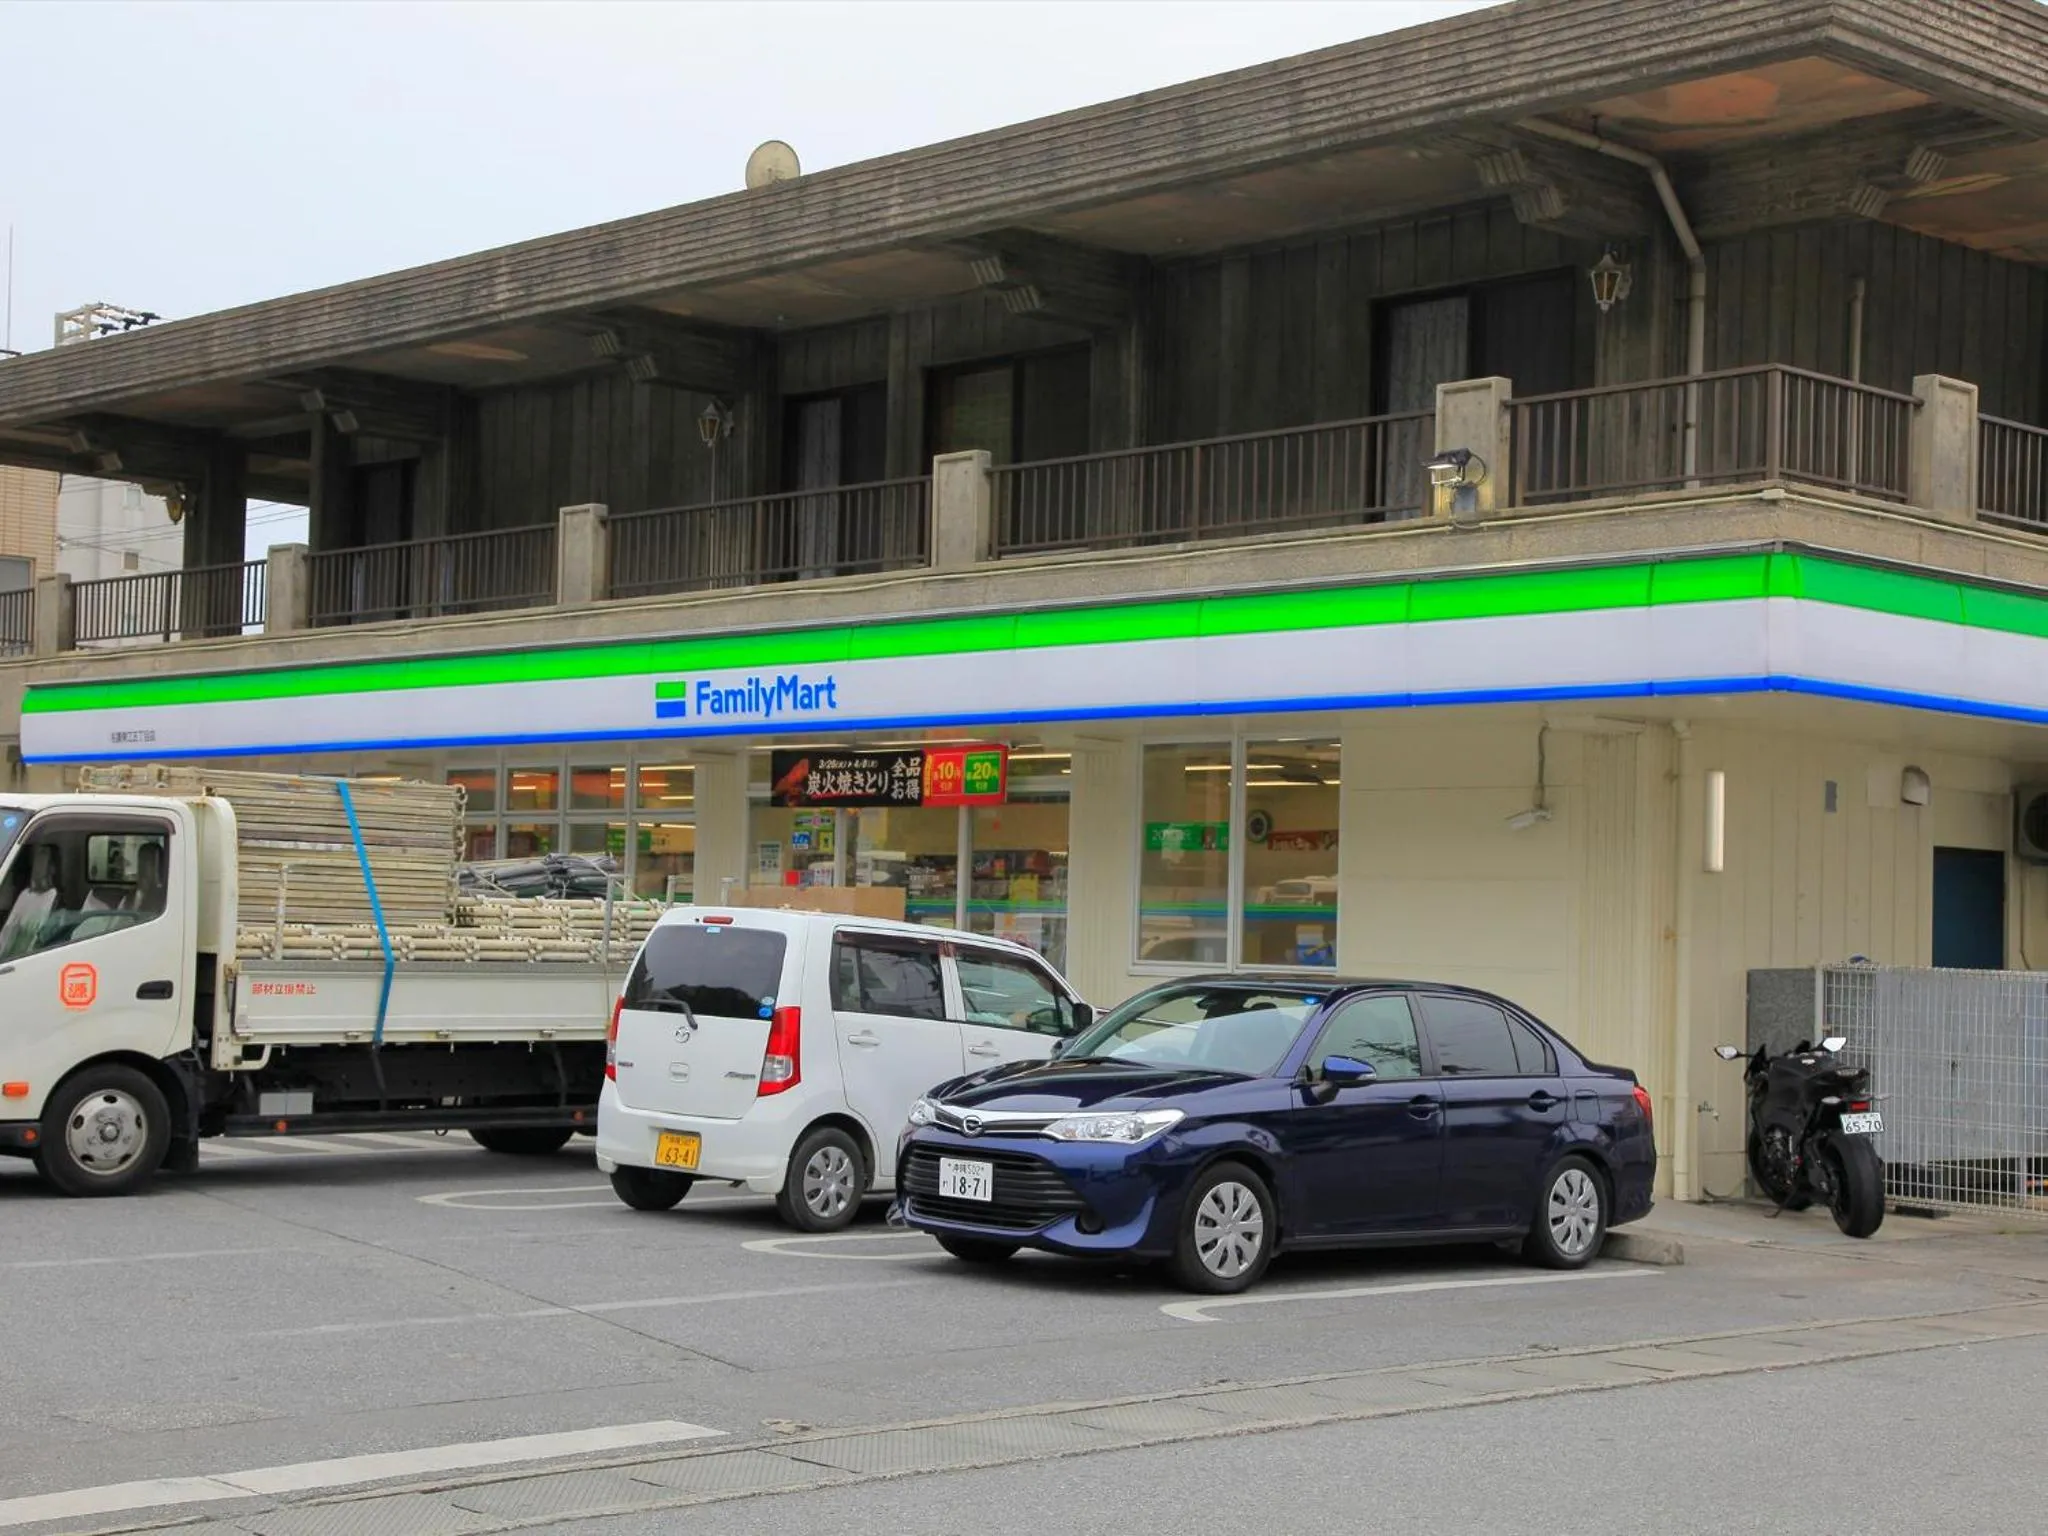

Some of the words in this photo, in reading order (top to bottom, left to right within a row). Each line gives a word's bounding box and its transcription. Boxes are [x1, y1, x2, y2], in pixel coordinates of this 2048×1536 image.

[696, 674, 836, 717] FamilyMart
[891, 756, 920, 777] 全品
[807, 770, 888, 795] 炭火焼きとり
[891, 779, 920, 800] お得
[1845, 1120, 1882, 1132] 65-70
[952, 1175, 987, 1198] 18-71
